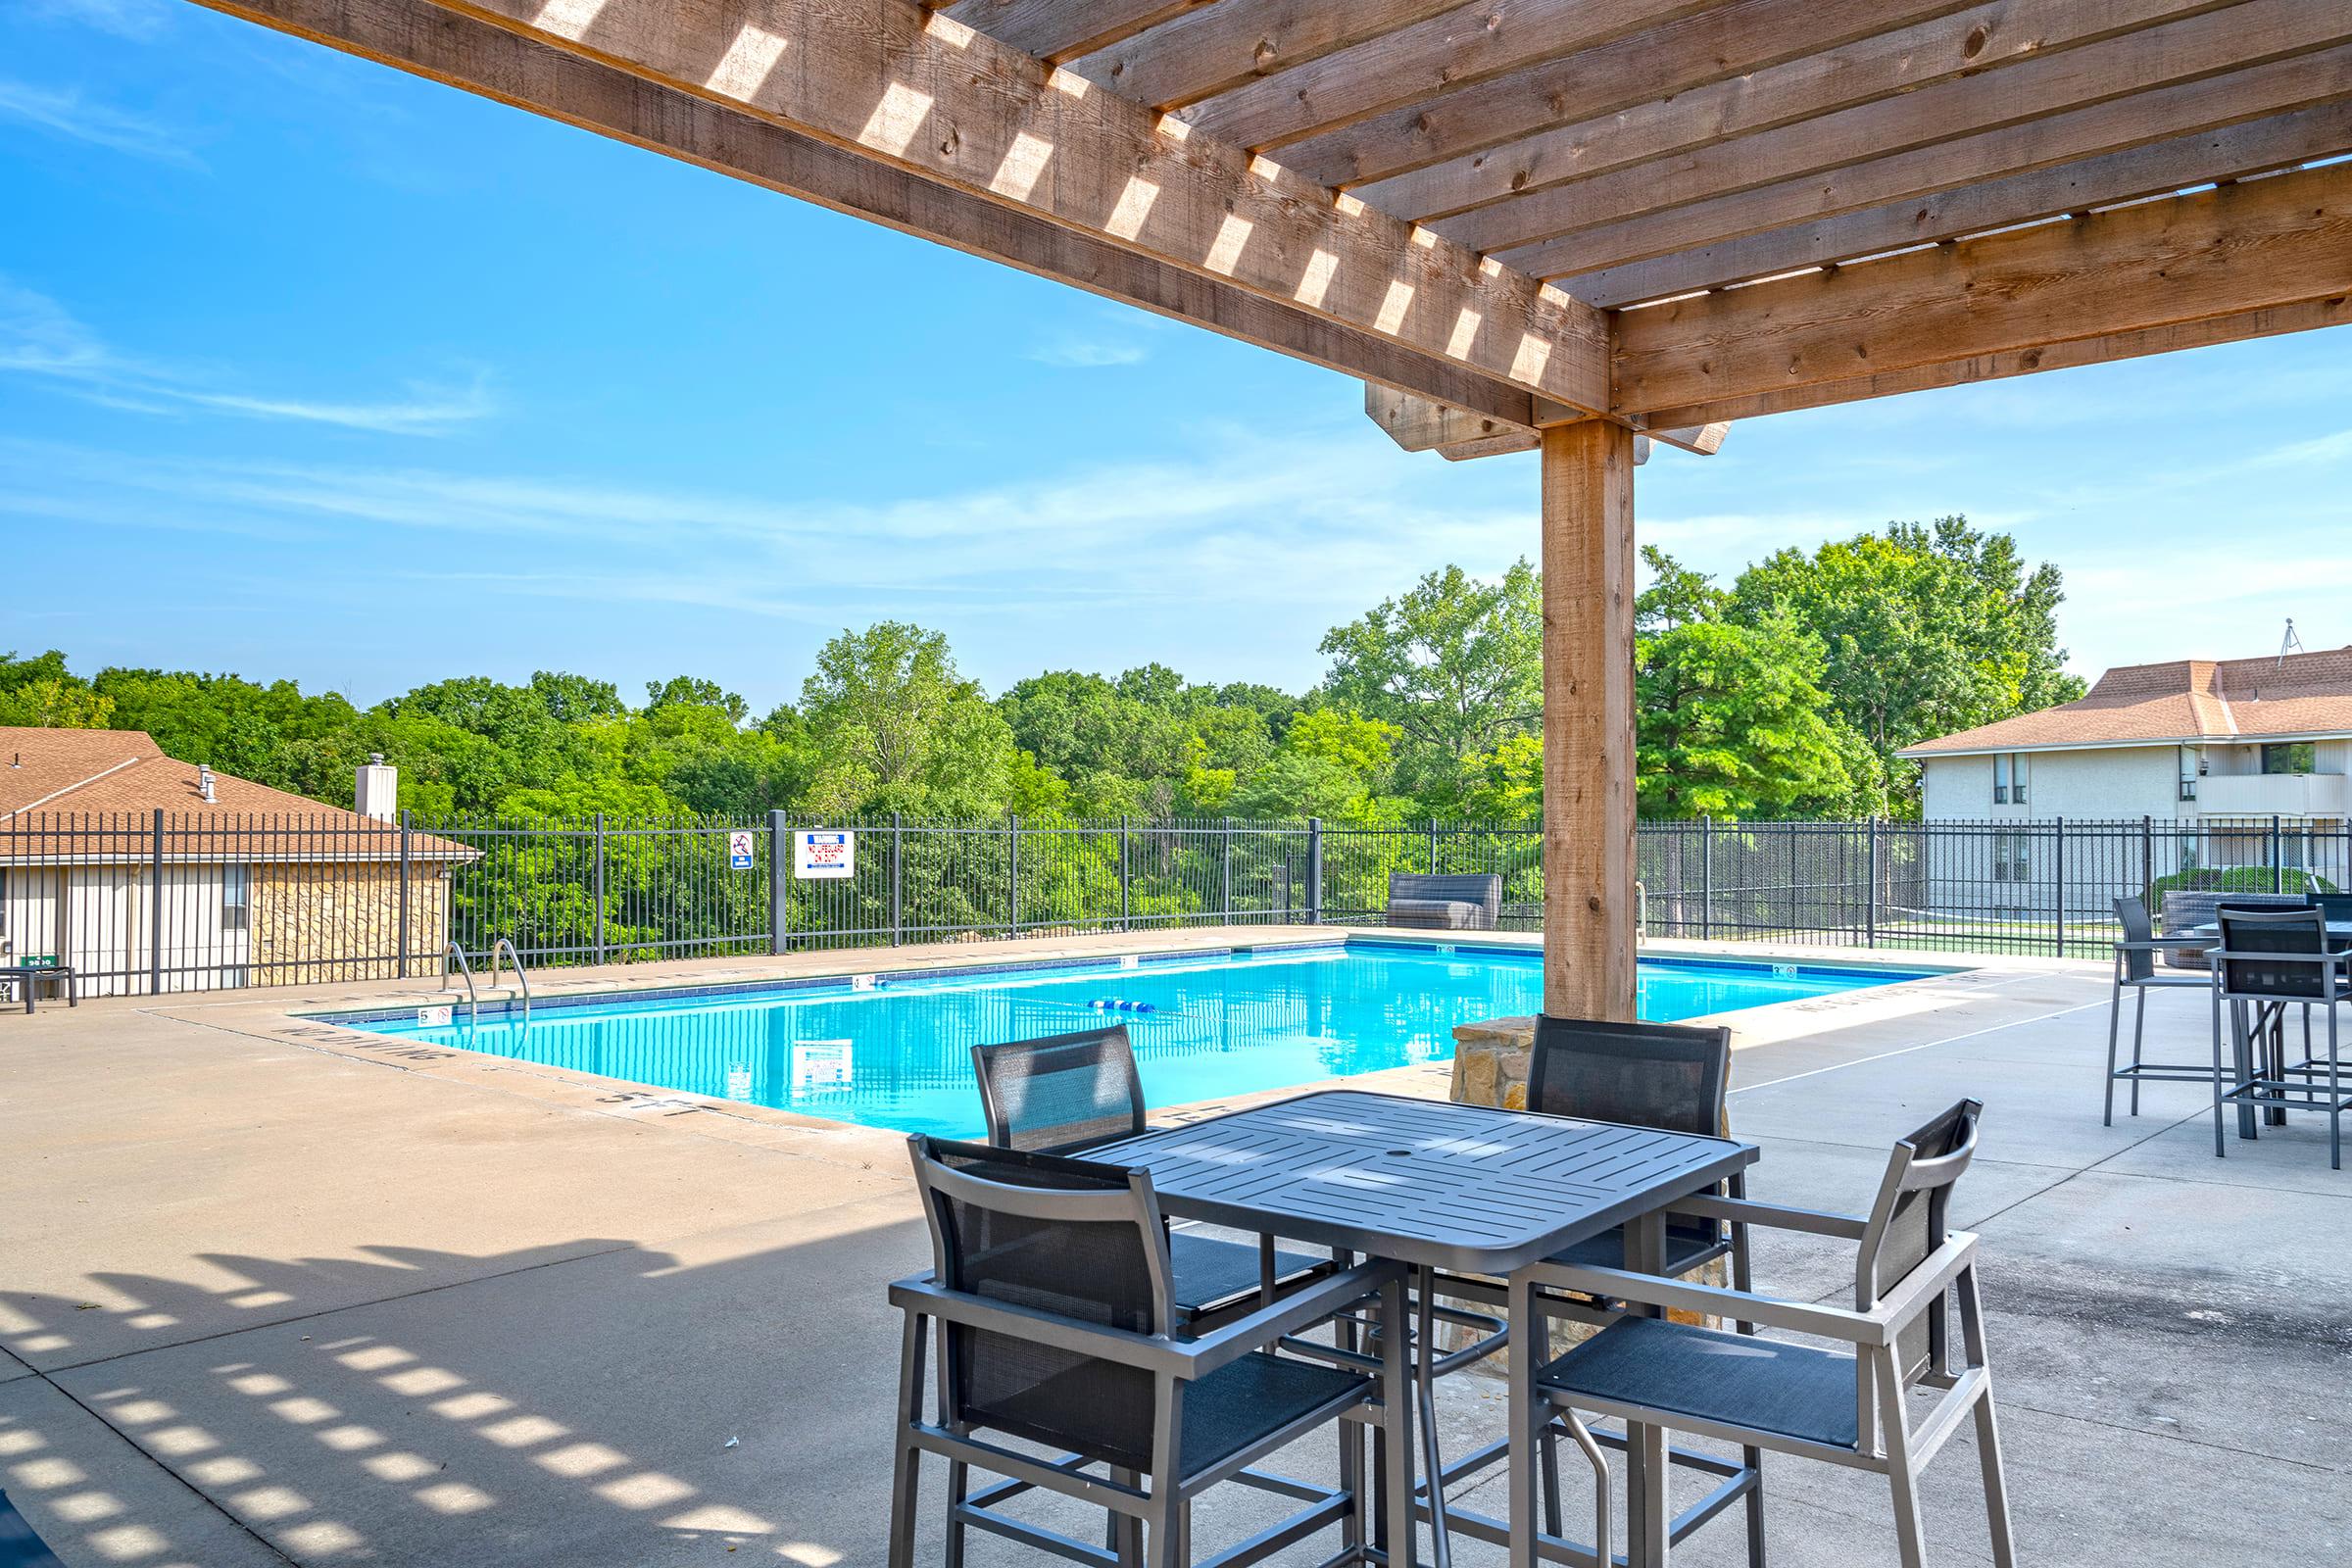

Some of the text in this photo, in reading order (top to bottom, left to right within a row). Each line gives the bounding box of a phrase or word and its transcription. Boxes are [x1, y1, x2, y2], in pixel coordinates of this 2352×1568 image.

[814, 854, 822, 862] ON
[420, 1010, 428, 1020] 5
[314, 1035, 458, 1060] DIVING
